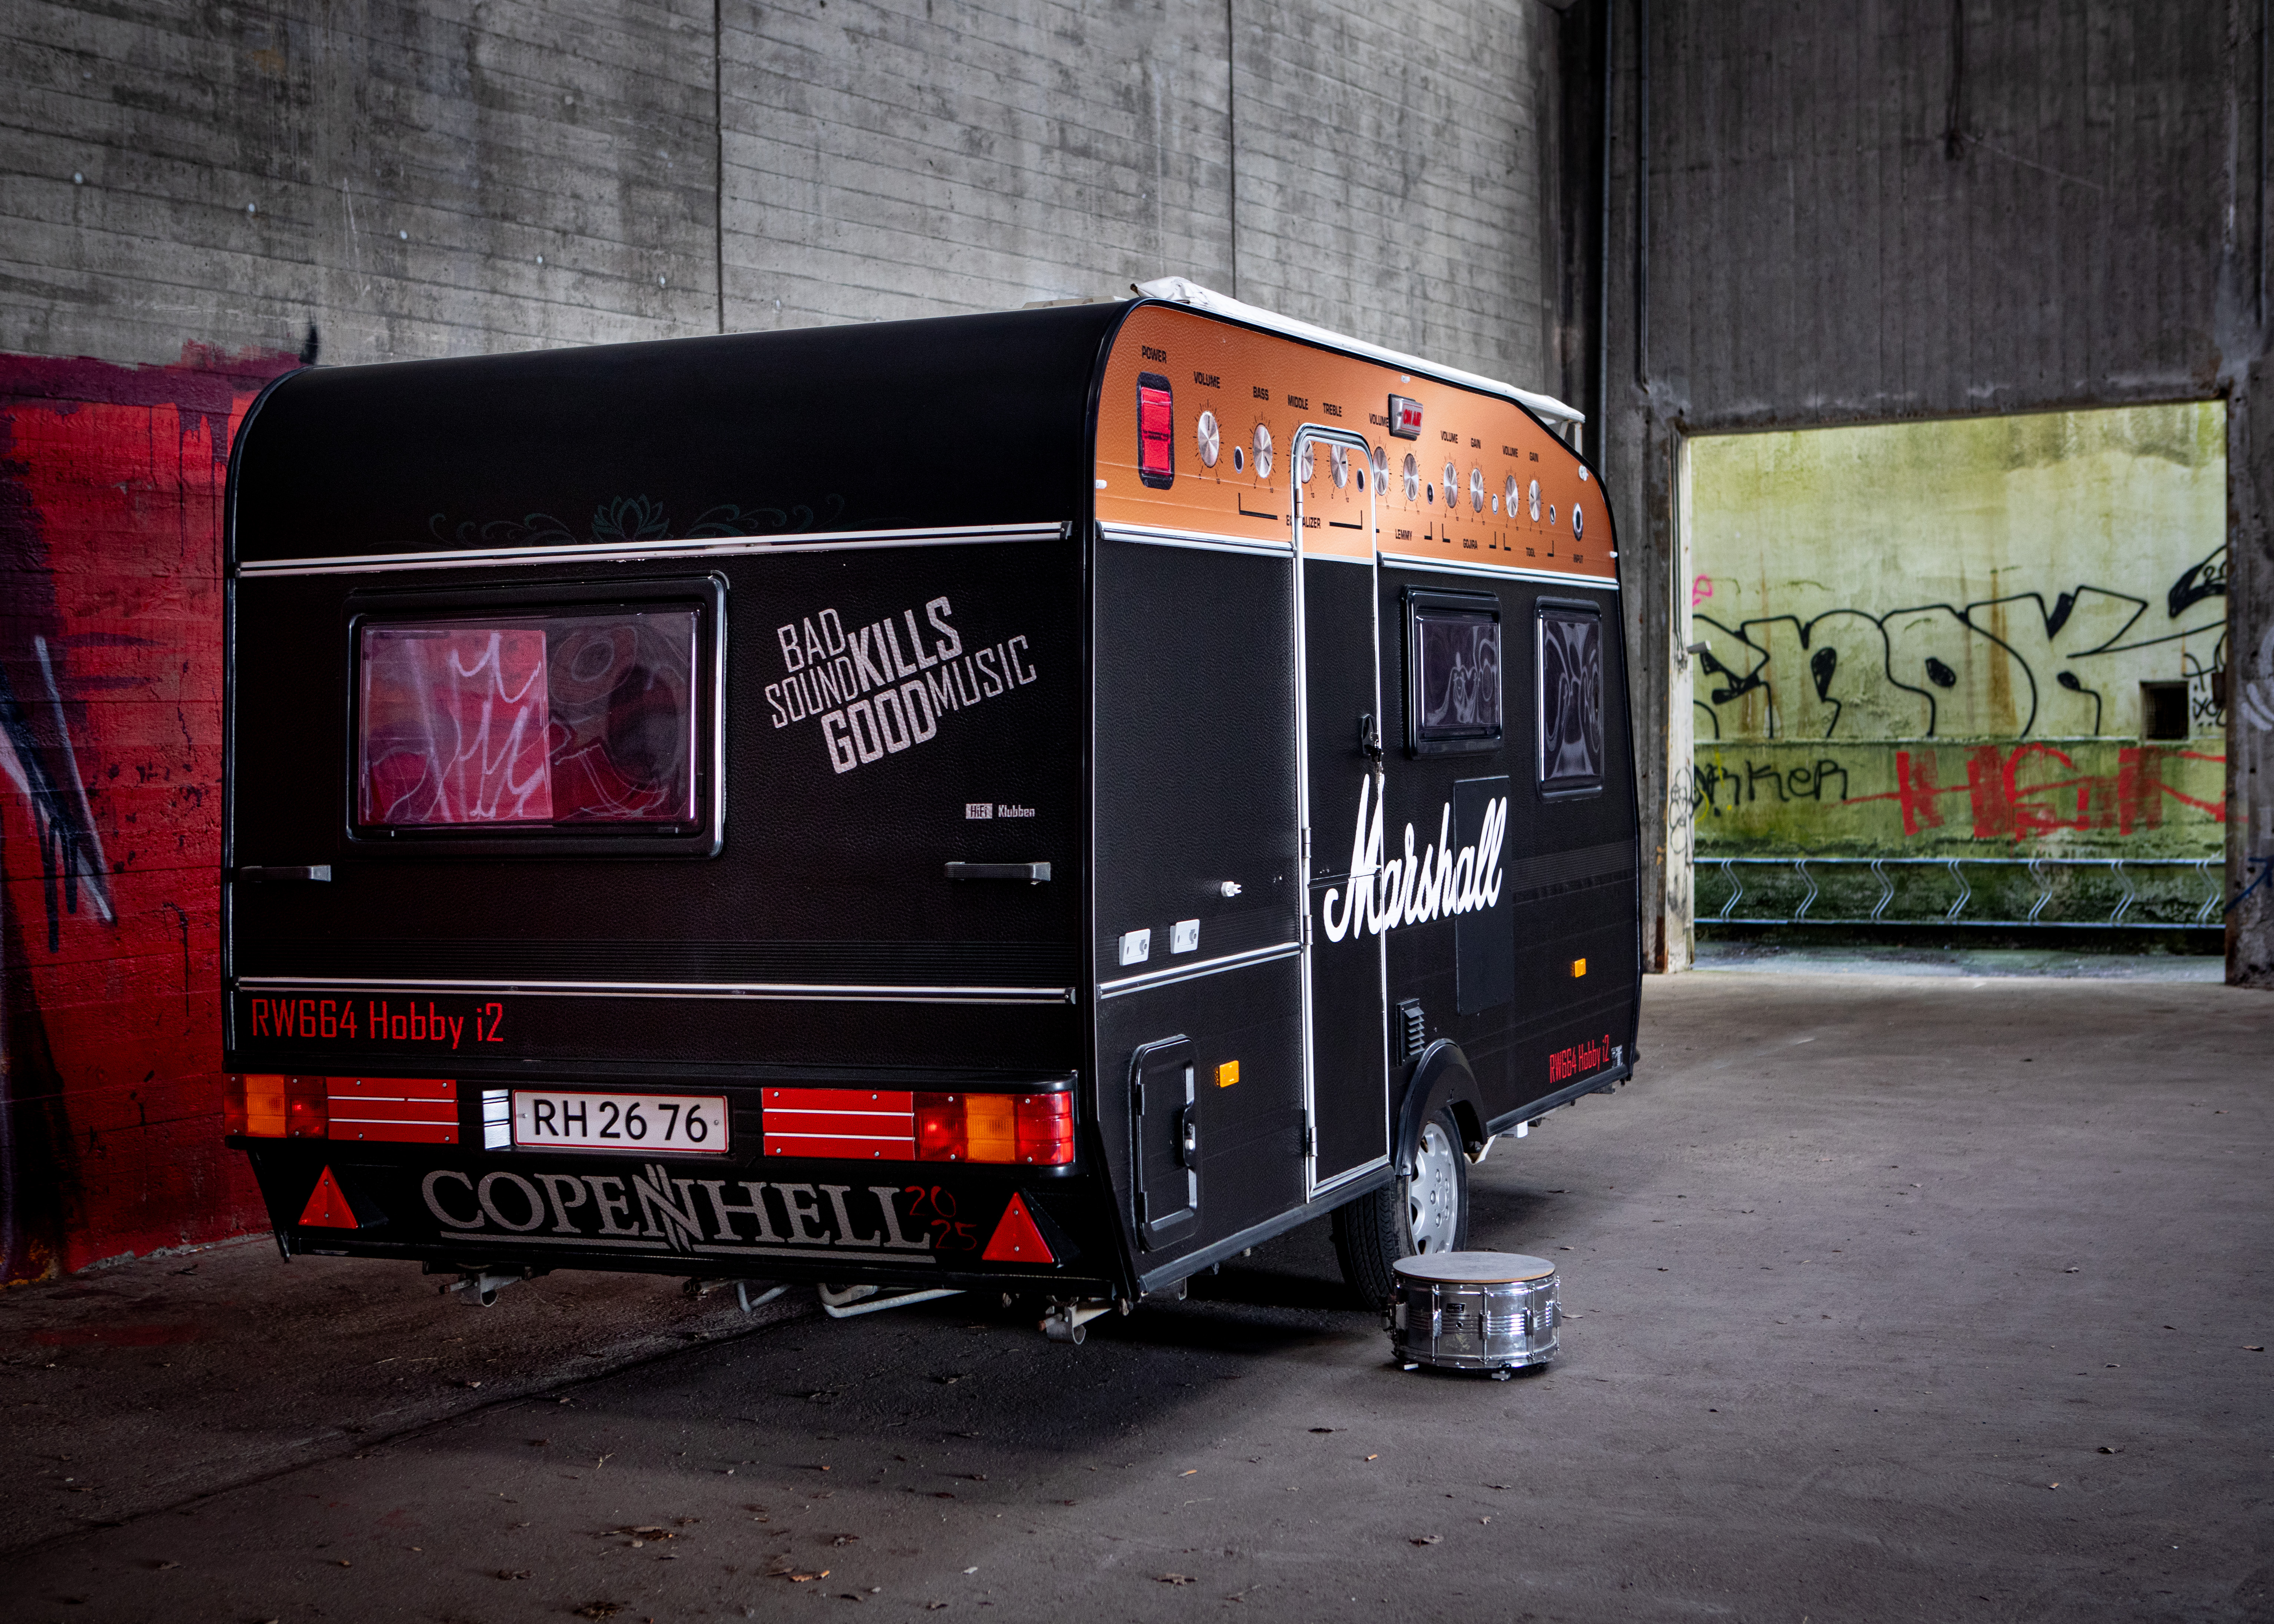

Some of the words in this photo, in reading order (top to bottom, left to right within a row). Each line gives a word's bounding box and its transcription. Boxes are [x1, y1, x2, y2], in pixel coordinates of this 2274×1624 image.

[1142, 345, 1167, 363] POWER
[1194, 371, 1220, 389] VOLUME
[1253, 386, 1269, 401] BASS
[1288, 394, 1308, 410] MIDDLE
[1323, 402, 1342, 417] TREBLE
[1403, 409, 1412, 425] ON
[1412, 411, 1421, 427] AIR
[1369, 413, 1389, 427] VOLUME
[1441, 430, 1458, 443] VOLUME
[1471, 437, 1481, 449] GAIN
[1502, 445, 1518, 457] VOLUME
[1529, 451, 1538, 462] GAIN
[1286, 515, 1321, 529] EALIZER
[1395, 529, 1412, 541] LEMMY
[1463, 538, 1478, 550] GOJIRA
[777, 608, 846, 673] BAD
[764, 656, 858, 729] SOUND
[847, 596, 963, 692] KILLS
[821, 680, 937, 774] GOOD
[925, 635, 1037, 717] MUSIC
[970, 805, 987, 817] HiFi
[998, 805, 1035, 817] Klubben
[1324, 773, 1507, 942] Marshall
[252, 999, 358, 1038] RW664
[369, 1001, 464, 1049] Hobby
[477, 1002, 504, 1042] i2
[1549, 1046, 1577, 1084] RW664
[1578, 1039, 1601, 1071] Hobby
[1602, 1034, 1610, 1063] i2
[533, 1099, 588, 1138] RH
[599, 1101, 648, 1141] 26
[658, 1103, 708, 1143] 76
[422, 1164, 931, 1252] COPENHELL
[905, 1185, 956, 1218] 20
[931, 1219, 977, 1250] 25
